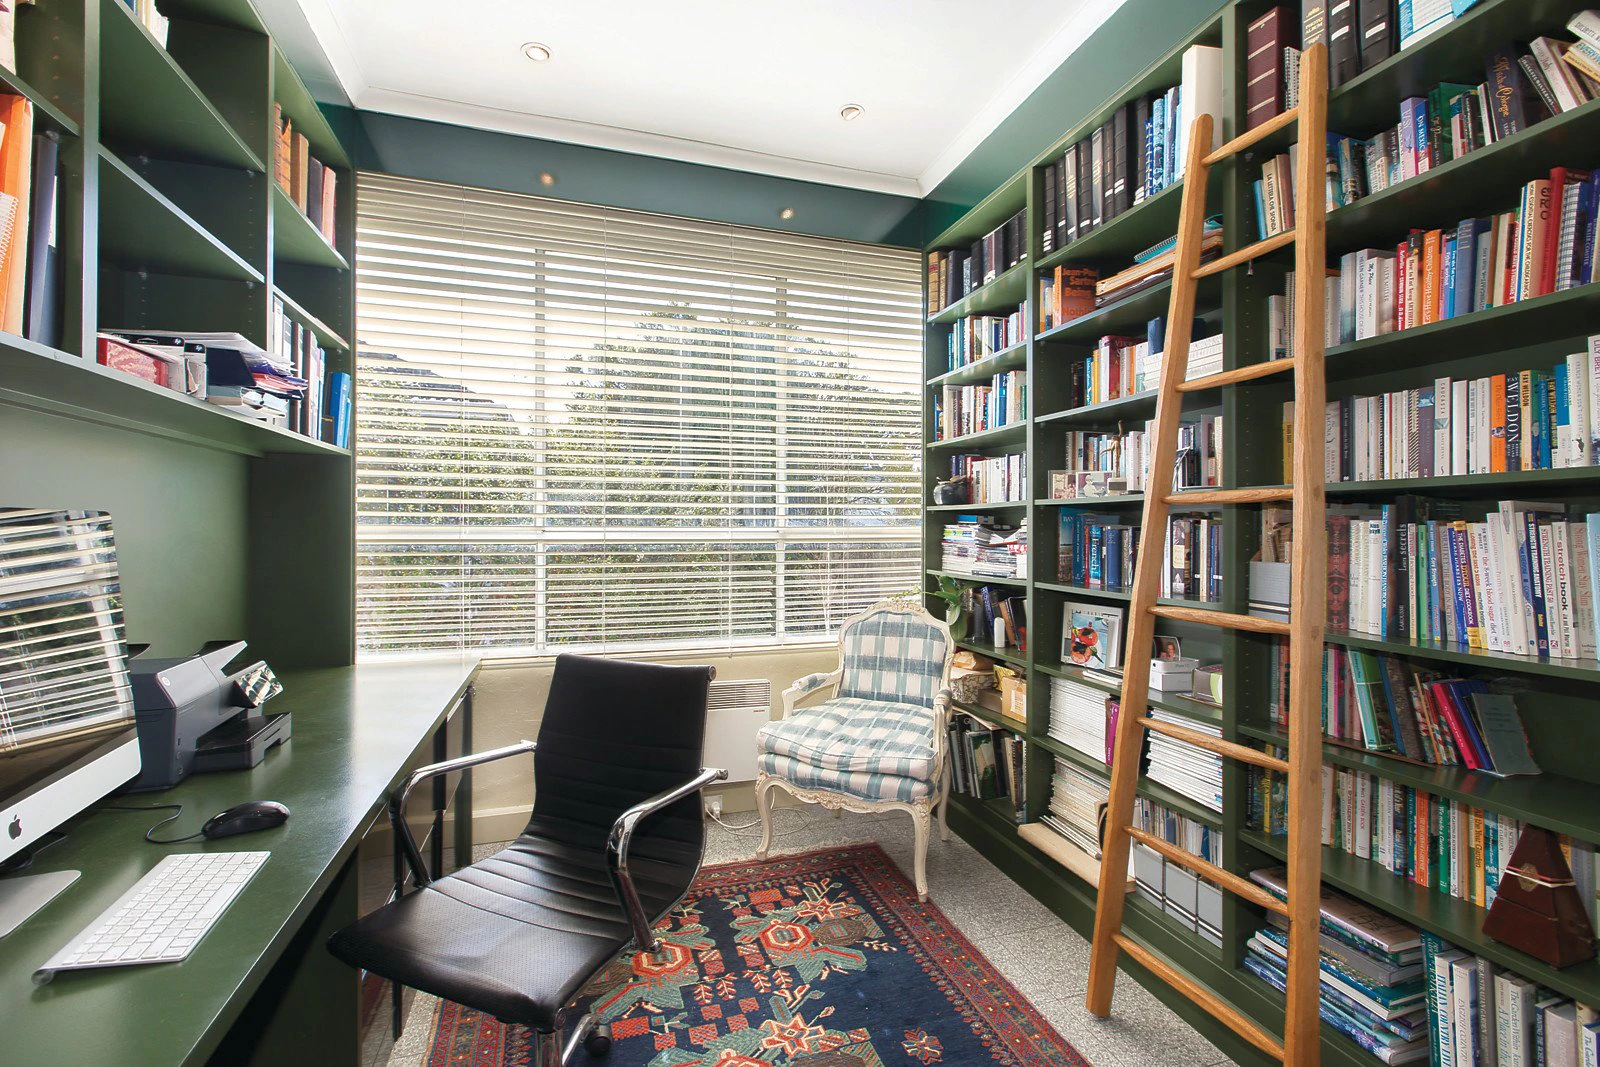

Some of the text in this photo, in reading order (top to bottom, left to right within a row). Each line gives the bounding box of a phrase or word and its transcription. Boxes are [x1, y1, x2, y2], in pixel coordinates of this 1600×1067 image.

[1305, 22, 1323, 34] ALBUM
[1306, 17, 1323, 29] PHOTO
[1417, 114, 1427, 159] ON MEXICAN
[1266, 173, 1273, 181] LA
[1368, 263, 1374, 272] My
[1425, 271, 1433, 294] Healthy
[1507, 382, 1519, 442] WELDON
[1396, 523, 1407, 555] secrets
[1541, 529, 1549, 556] STRENGTH
[1575, 527, 1585, 549] Strong
[1092, 538, 1100, 570] French
[1529, 524, 1542, 598] STRENGTH TRAINING ANATOMY
[1557, 541, 1566, 581] stretch
[1578, 550, 1588, 573] Women
[1484, 567, 1492, 587] 8-week
[1543, 557, 1552, 583] TRAINING
[1458, 543, 1466, 563] DIABETES
[1465, 599, 1474, 624] COOKBOOK
[1578, 575, 1589, 590] Stay
[1486, 588, 1494, 605] blood
[1560, 581, 1569, 611] book
[1581, 591, 1592, 606] Slim
[1478, 611, 1486, 627] bridges
[1486, 605, 1494, 622] sugar
[1439, 806, 1445, 815] We
[1475, 843, 1483, 868] Garden
[1437, 974, 1451, 1045] ITALIAN COUNTRY
[1511, 990, 1520, 1049] The Garden Within
[1458, 998, 1468, 1064] ENGLISH COUNTRY
[1499, 1016, 1508, 1040] Place
[1584, 1035, 1592, 1046] The
[1501, 1048, 1510, 1061] the
